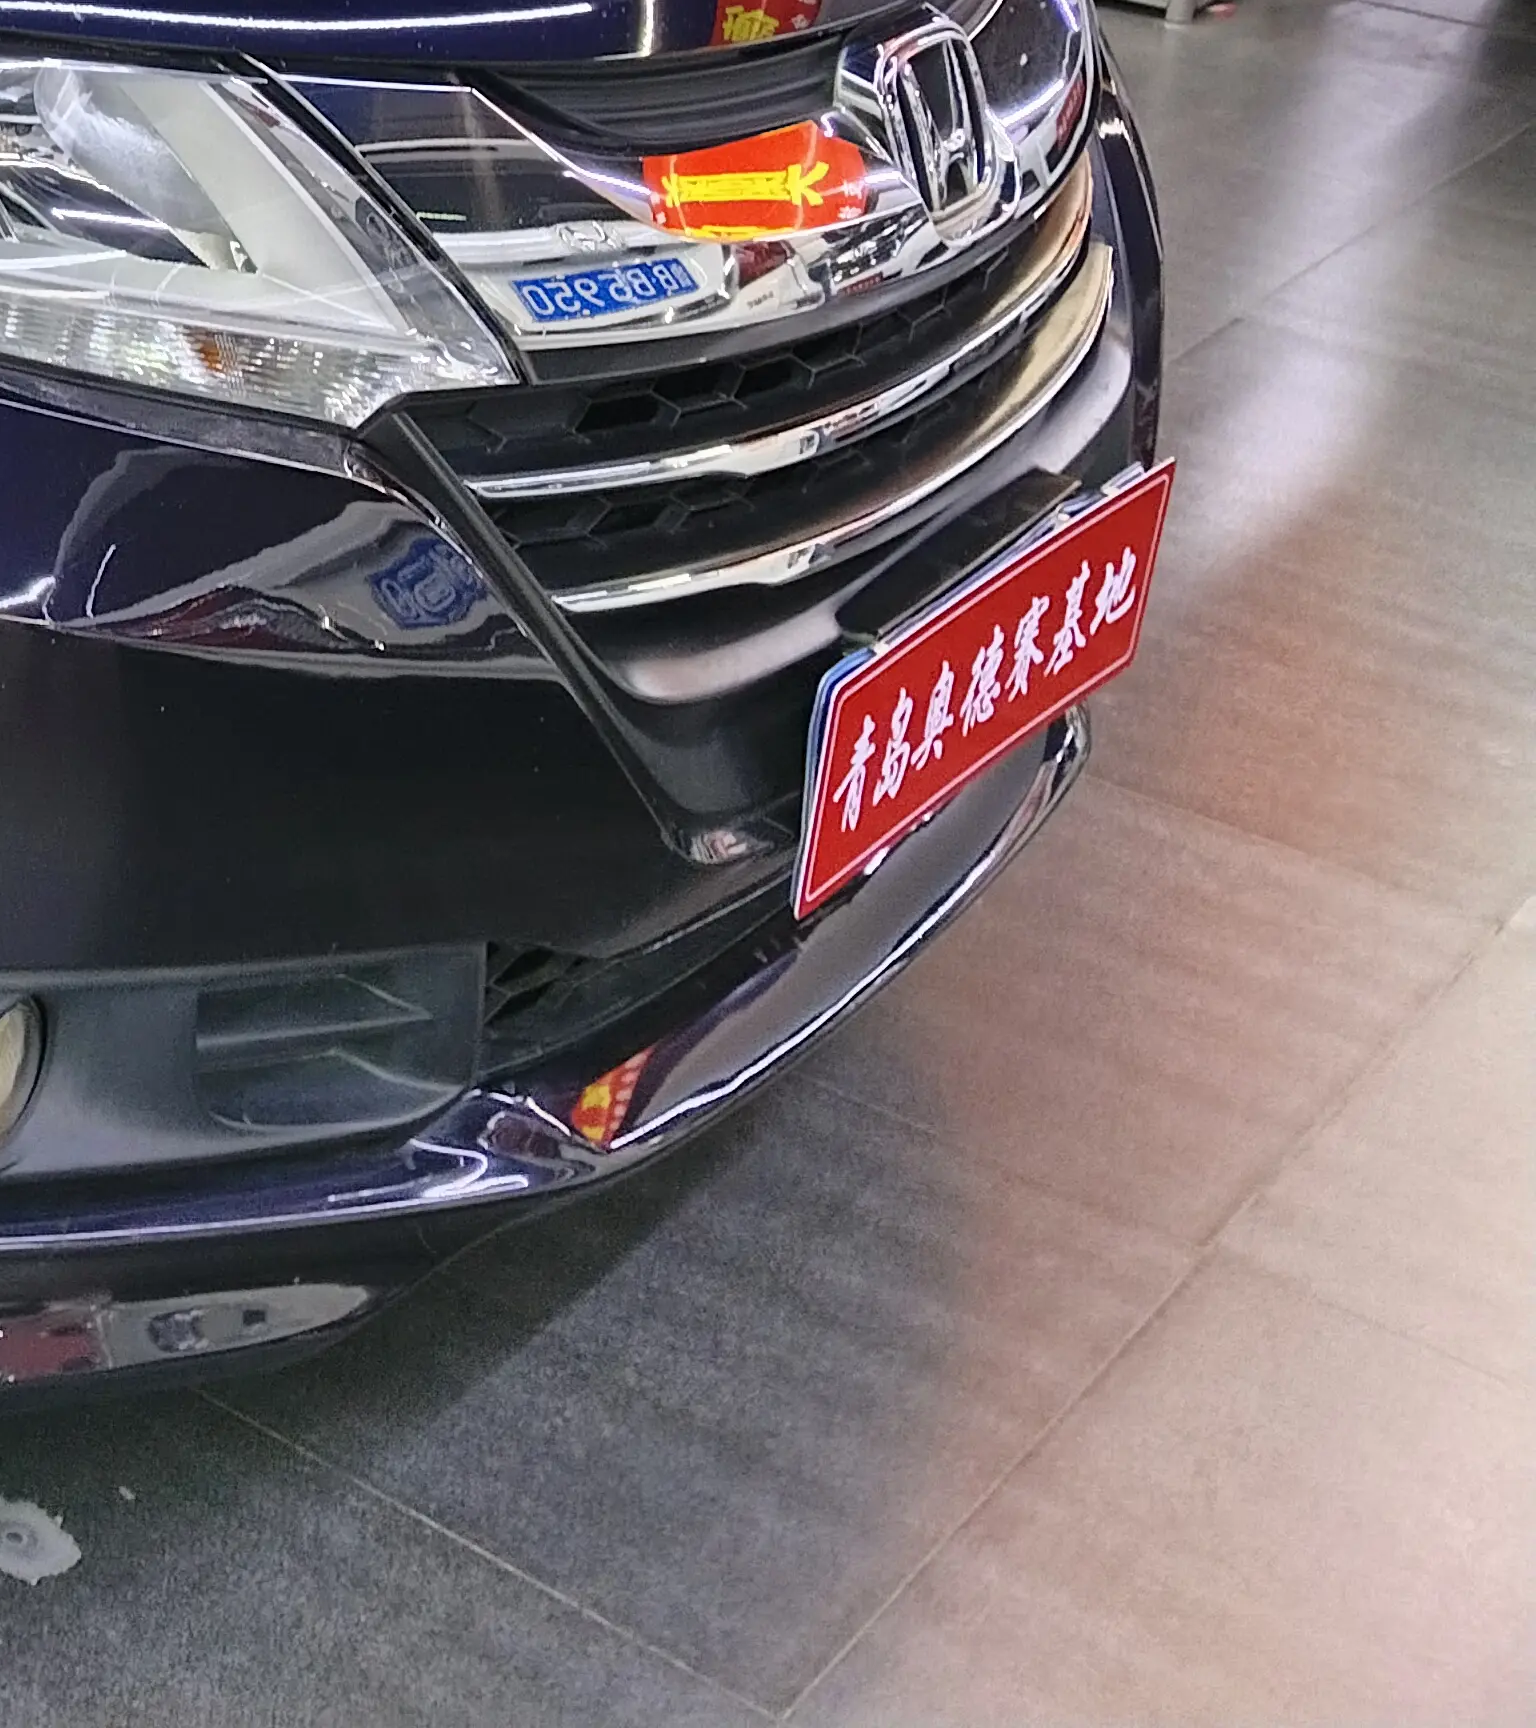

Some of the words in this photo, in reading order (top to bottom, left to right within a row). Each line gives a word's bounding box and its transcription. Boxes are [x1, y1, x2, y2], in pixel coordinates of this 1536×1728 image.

[833, 546, 1138, 832] 青岛奥德赛基地
